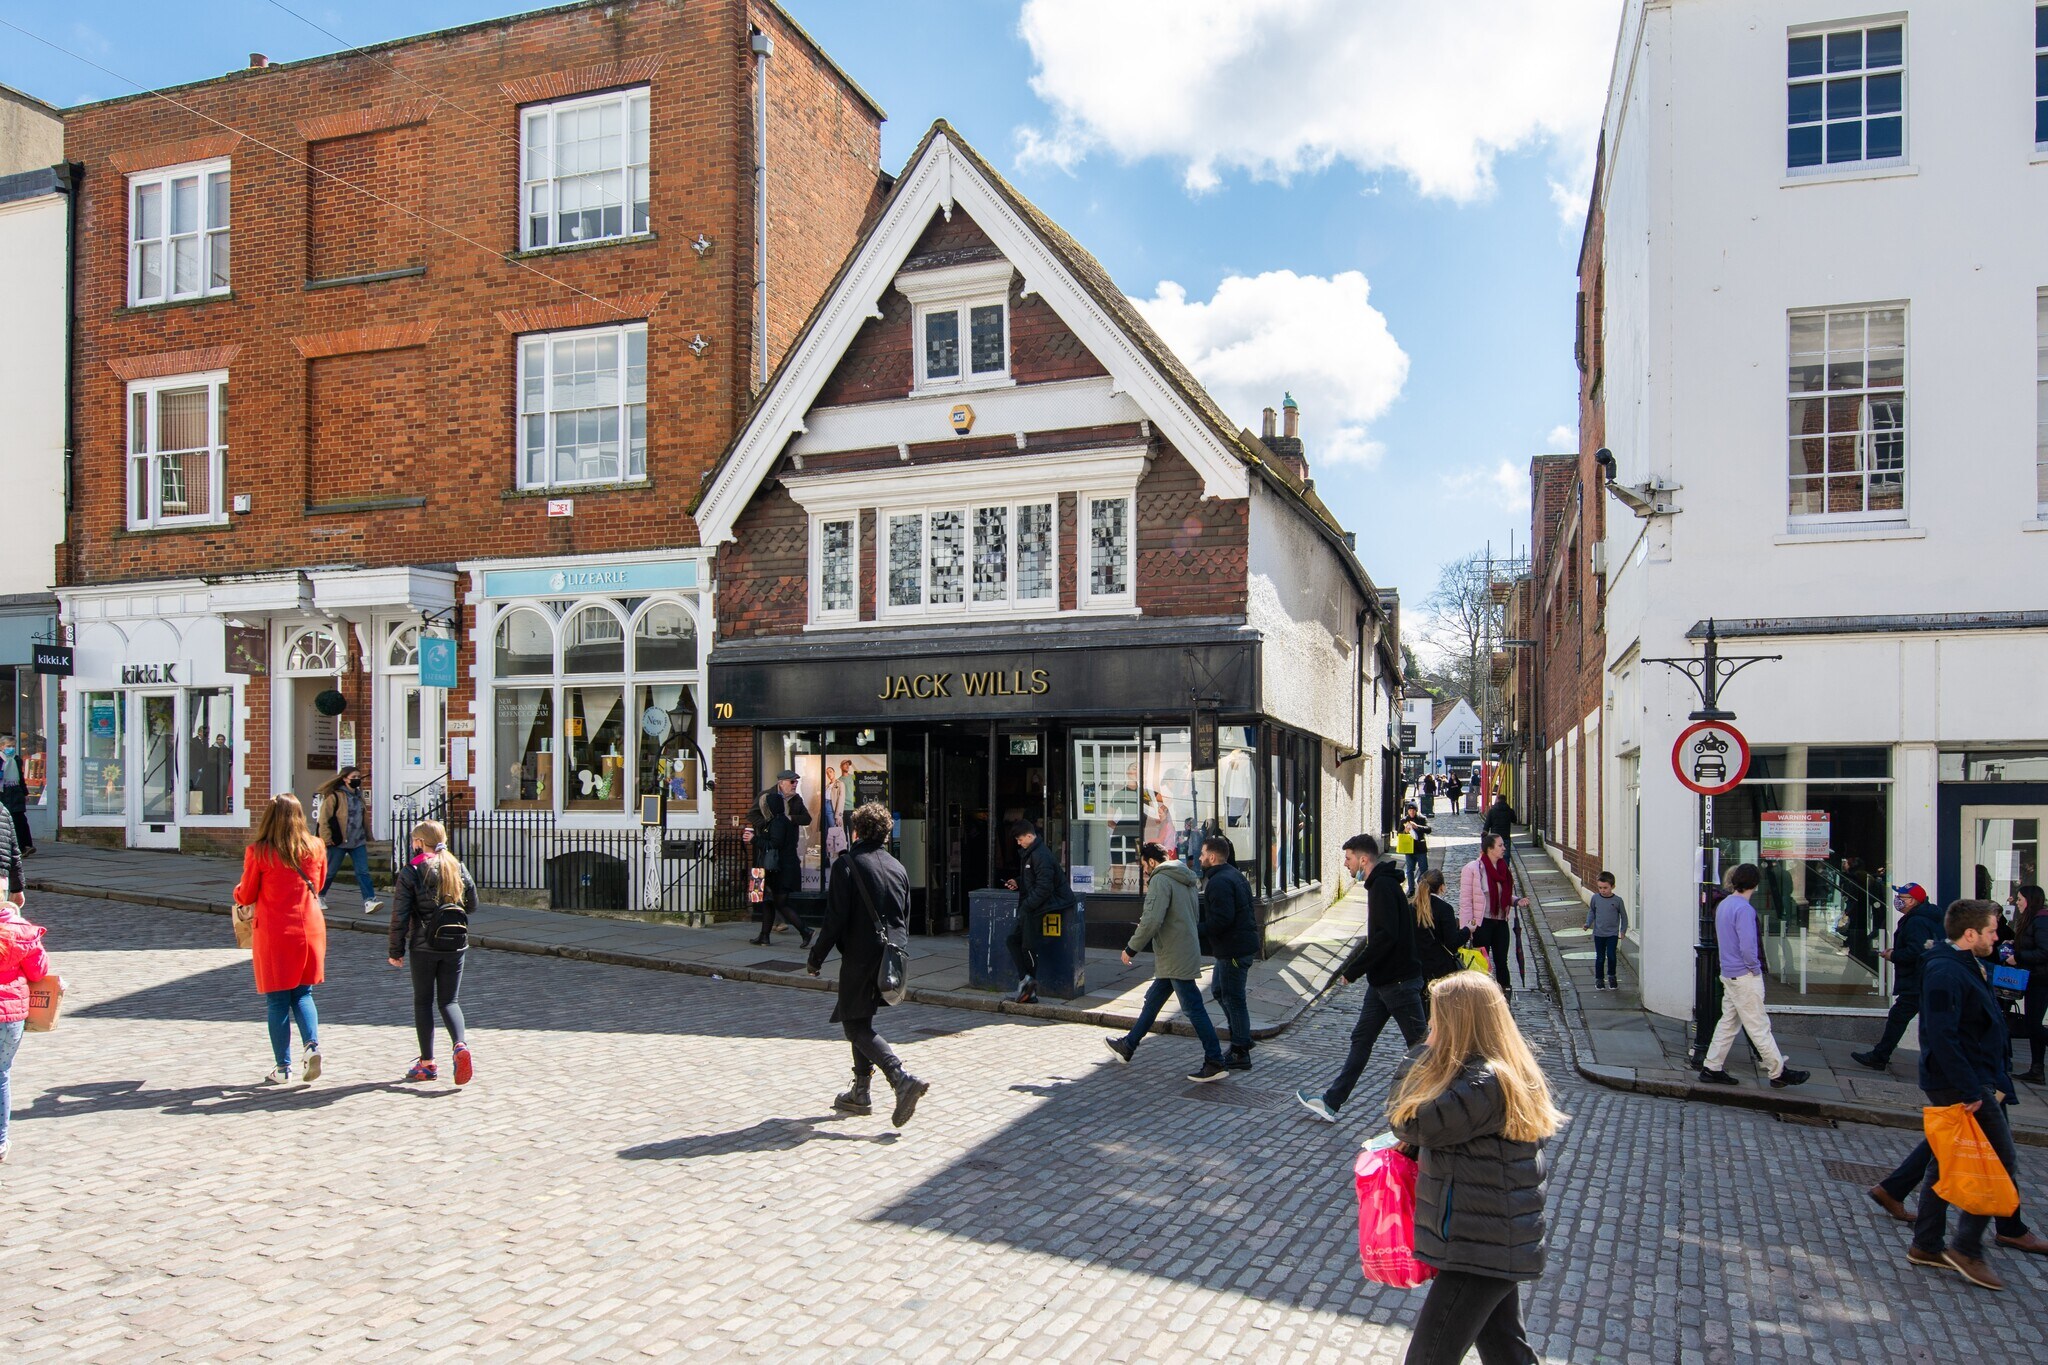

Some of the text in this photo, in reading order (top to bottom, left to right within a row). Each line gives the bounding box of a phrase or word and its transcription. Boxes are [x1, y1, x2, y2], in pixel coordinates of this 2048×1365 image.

[568, 570, 628, 585] LIZ EARLE
[37, 654, 70, 666] kikki.K
[121, 663, 177, 685] kikki.K
[878, 669, 1050, 700] JACK WILLS
[714, 703, 733, 719] 70
[1046, 916, 1059, 934] H
[30, 996, 48, 1008] ORK
